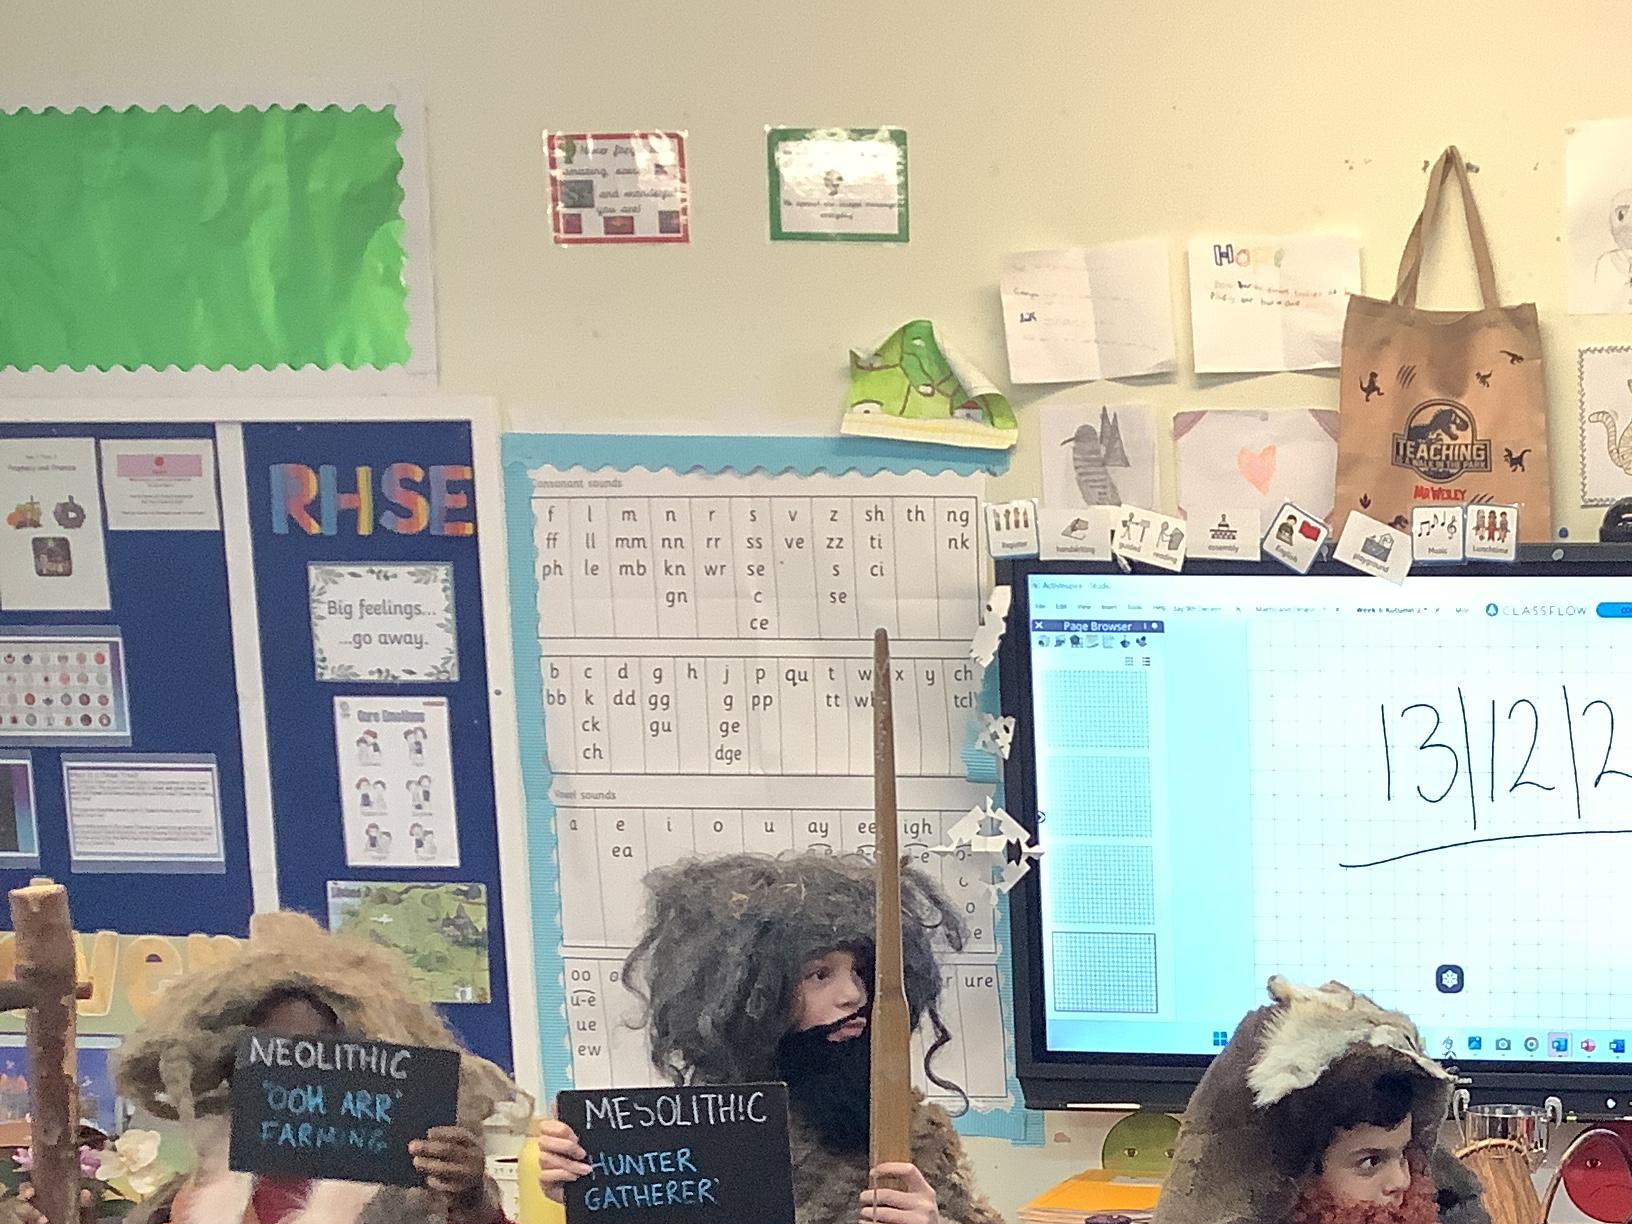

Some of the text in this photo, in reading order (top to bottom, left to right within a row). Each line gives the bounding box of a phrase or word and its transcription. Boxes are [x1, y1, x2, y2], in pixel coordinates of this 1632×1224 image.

[1396, 439, 1485, 461] TEACHING
[1463, 460, 1486, 469] PARK
[269, 463, 474, 535] RHSE
[745, 532, 970, 550] ss ve zz ti nk
[1118, 541, 1142, 553] guided
[1471, 544, 1509, 555] Lunchtime
[1152, 551, 1178, 565] reading
[1427, 546, 1449, 555] Music
[541, 558, 885, 581] ph le mb kn wr se ci
[1352, 553, 1390, 574] playground
[664, 591, 848, 608] gn se
[327, 599, 437, 620] Big feelings...
[1503, 605, 1587, 616] CLASSFLOW
[748, 617, 769, 631] ce
[1063, 621, 1133, 632] Page Browser
[339, 633, 430, 650] ...go away.
[784, 663, 973, 687] qu ch
[545, 688, 841, 712] bb dd gg pp tt
[580, 715, 741, 738] ck gu ge
[581, 742, 742, 766] ch dge
[806, 817, 933, 840] ay igh
[610, 845, 633, 858] ea
[570, 969, 591, 982] oo
[963, 976, 994, 988] ure
[575, 1020, 597, 1032] ue
[249, 1036, 411, 1080] NEOLITHIC
[576, 1044, 602, 1057] ew
[584, 1091, 768, 1130] MESOLITHIC
[261, 1119, 388, 1151] FARMNG
